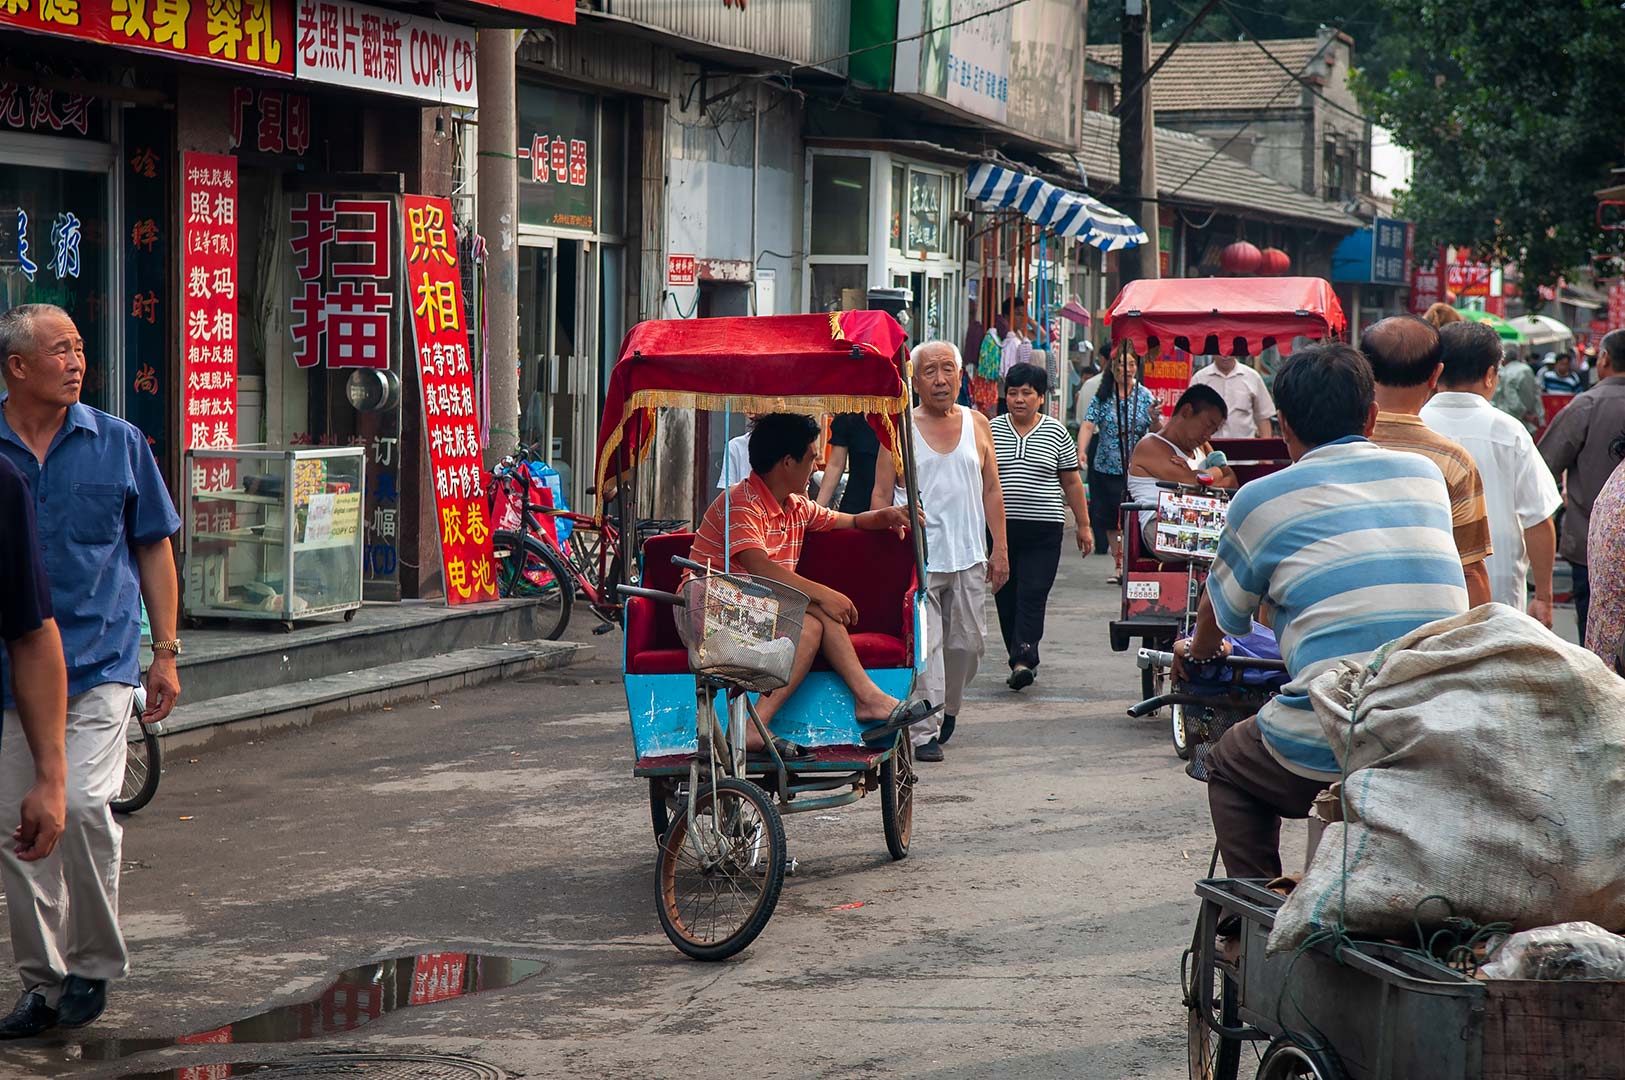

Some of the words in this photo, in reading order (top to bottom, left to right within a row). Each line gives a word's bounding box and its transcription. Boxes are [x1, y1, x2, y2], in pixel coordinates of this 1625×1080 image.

[298, 2, 402, 85] 老照片翻新
[410, 28, 448, 88] COPY
[453, 38, 473, 93] CD
[188, 168, 234, 188] 冲洗胶卷
[188, 192, 234, 225] 照相
[188, 265, 234, 299] 数码
[290, 193, 392, 370] 扫描
[408, 204, 460, 335] 照相
[188, 308, 234, 342] 洗相
[188, 345, 234, 364] 相片反拍
[421, 342, 469, 377] 立等可取
[188, 372, 234, 391] 处理照片
[188, 397, 234, 417] 翻新放大
[426, 383, 474, 417] 数码洗相
[190, 422, 234, 450] 胶卷
[432, 423, 479, 458] 冲洗胶卷
[192, 463, 233, 493] 电池
[436, 463, 484, 500] 相片修复
[442, 502, 489, 546] 胶卷
[448, 553, 495, 599] 电池
